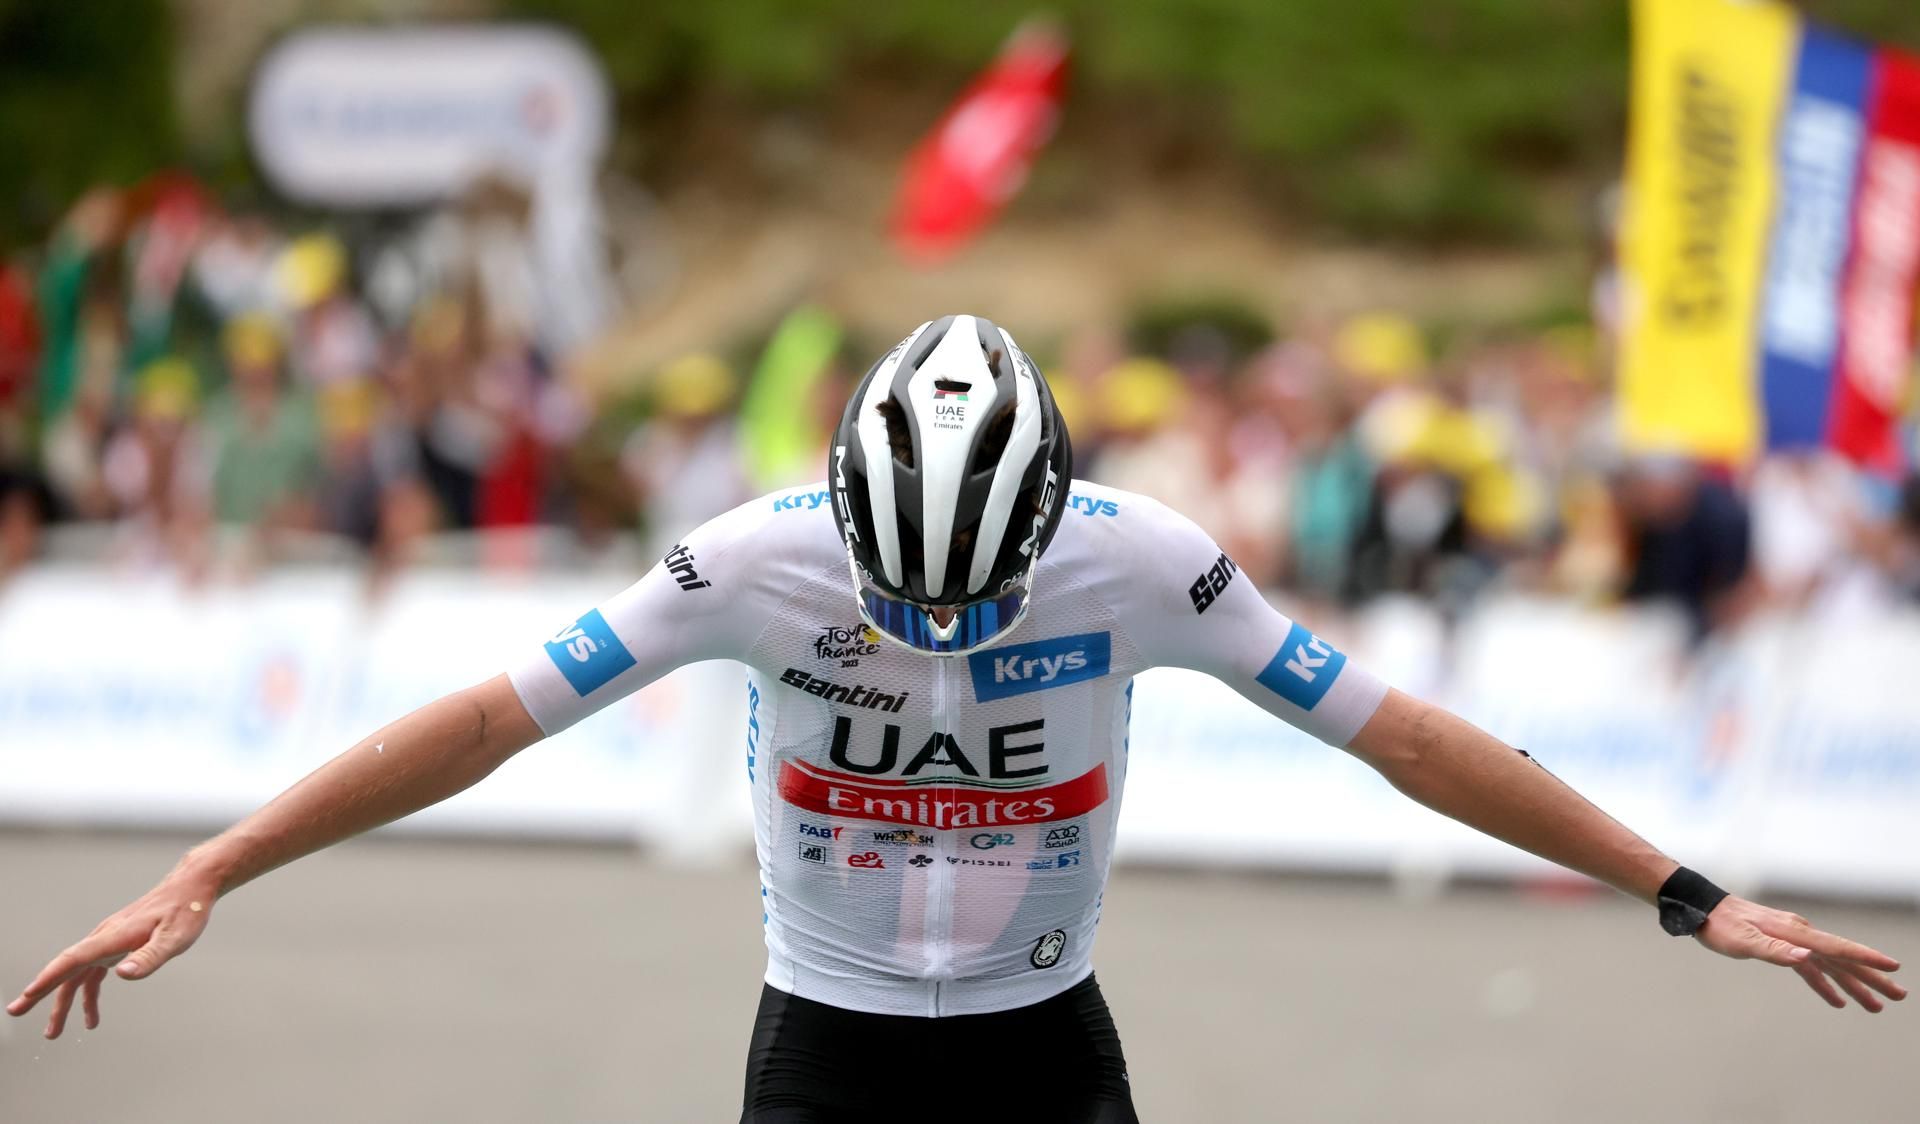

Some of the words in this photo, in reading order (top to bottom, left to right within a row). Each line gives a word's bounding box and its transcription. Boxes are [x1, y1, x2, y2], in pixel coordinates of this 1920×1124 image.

[935, 405, 965, 416] UAE
[934, 422, 963, 430] Emirates
[994, 650, 1088, 683] Krys
[779, 667, 909, 713] Santini
[829, 716, 1049, 779] UAE
[828, 786, 1056, 828] Emirates
[800, 823, 832, 839] FAB
[970, 833, 1015, 850] G42
[962, 859, 1011, 867] PISSEI
